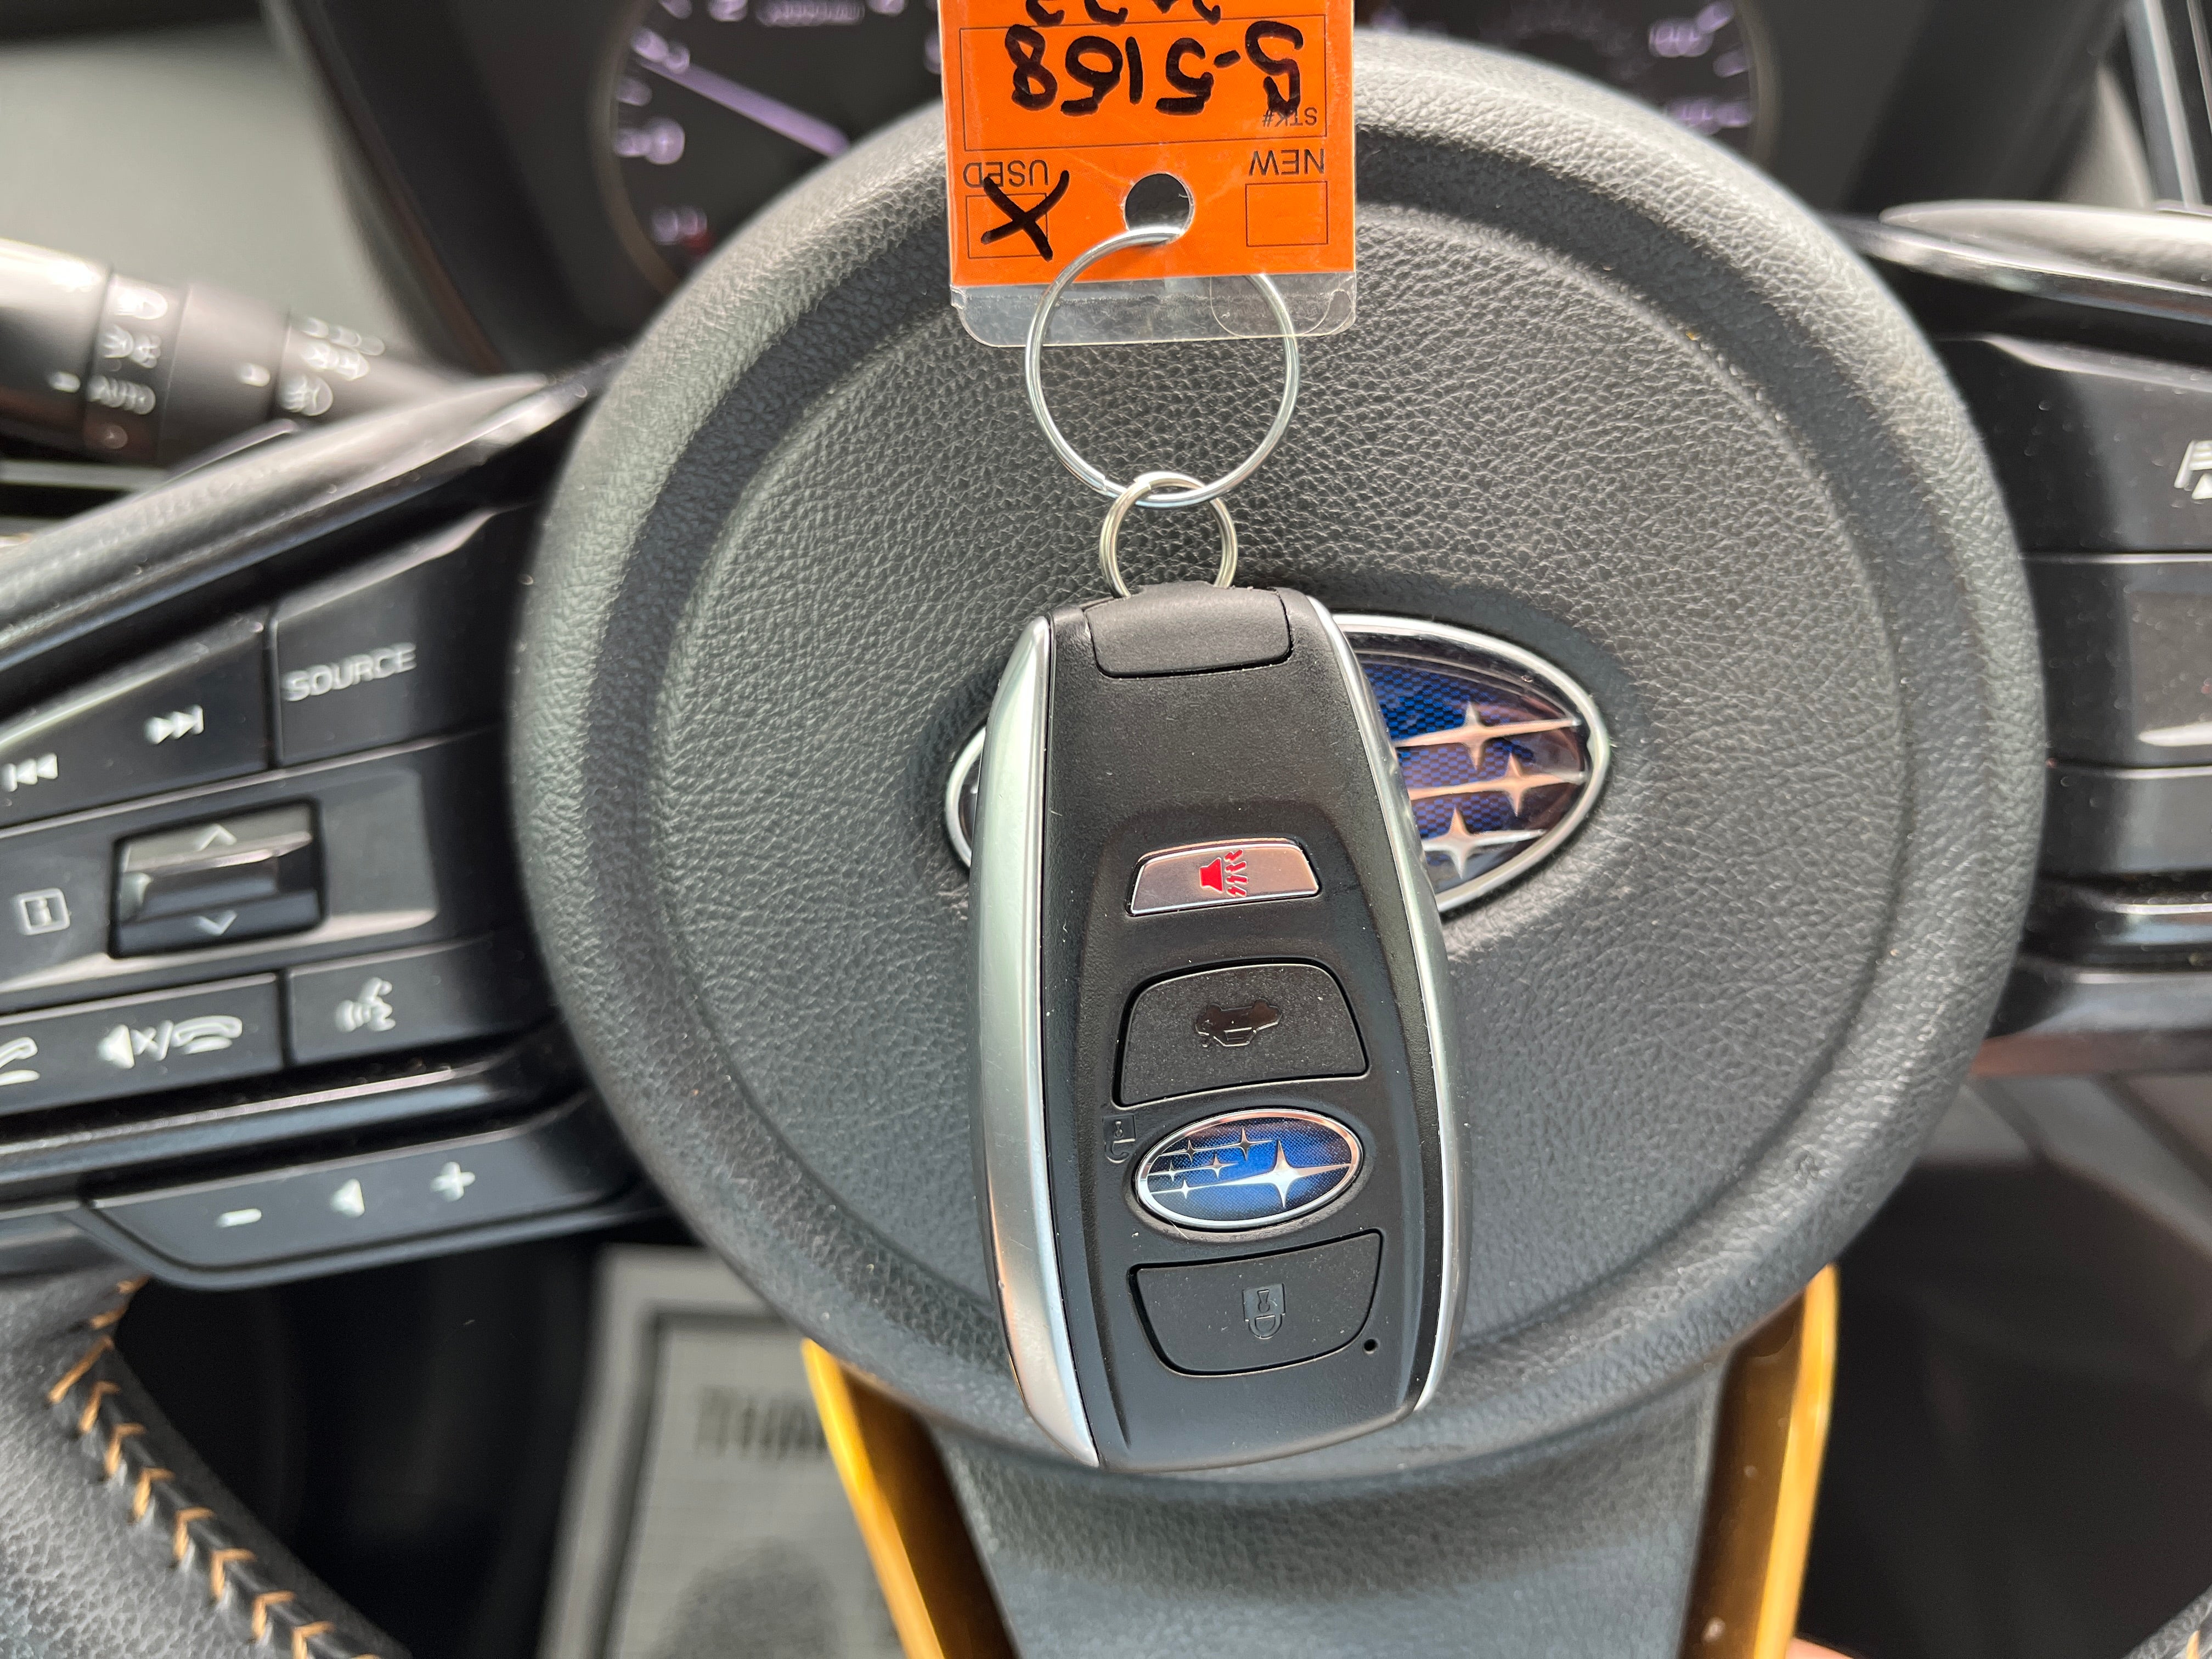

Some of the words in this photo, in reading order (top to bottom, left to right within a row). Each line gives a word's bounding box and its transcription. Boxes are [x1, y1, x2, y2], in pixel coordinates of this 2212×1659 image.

[963, 160, 1049, 188] USED
[1248, 148, 1325, 176] NEW
[284, 642, 417, 702] SOURCE
